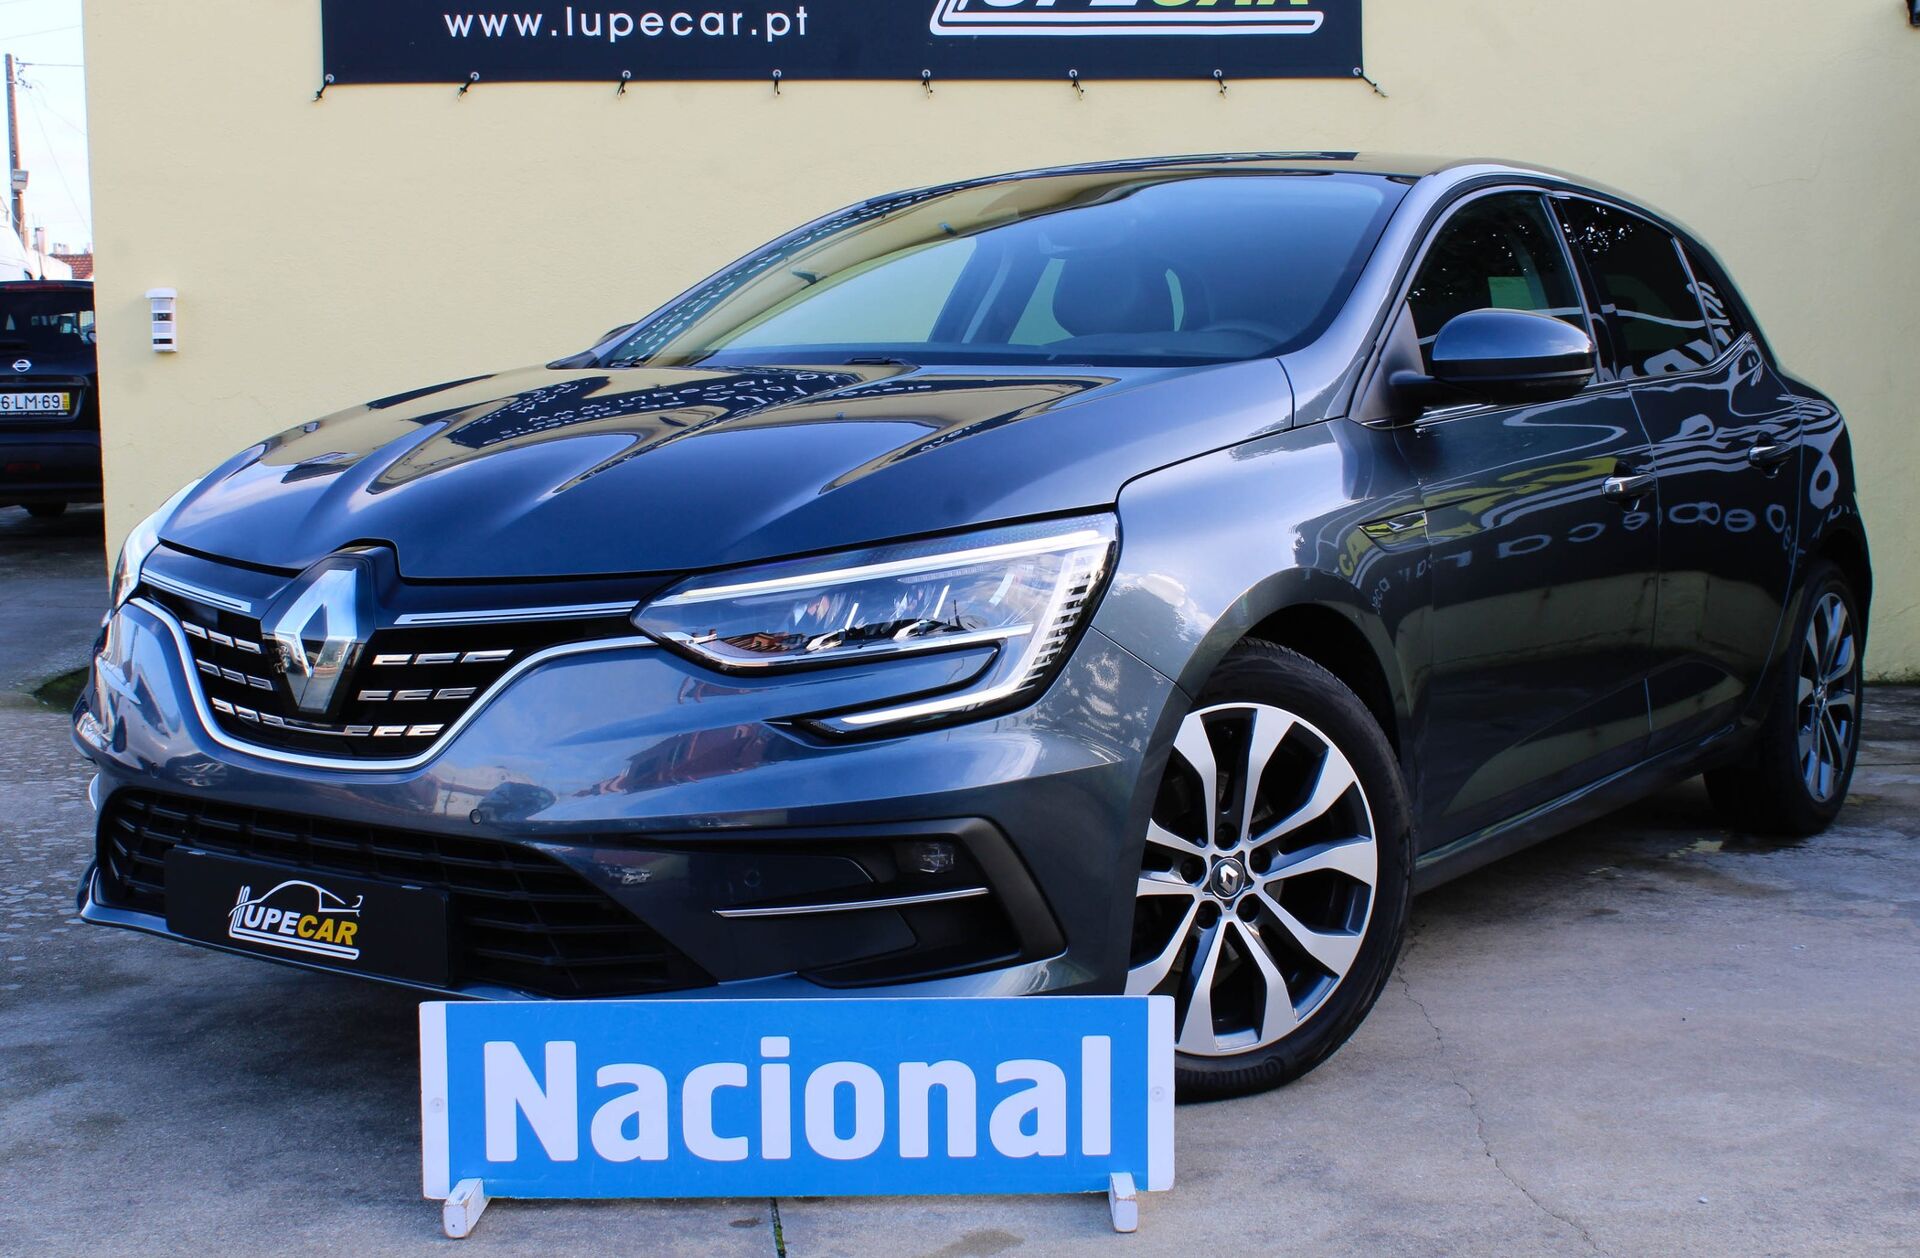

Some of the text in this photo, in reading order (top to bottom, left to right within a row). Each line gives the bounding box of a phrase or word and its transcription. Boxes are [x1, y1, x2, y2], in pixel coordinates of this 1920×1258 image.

[444, 6, 808, 42] www.lupecar.pt
[1, 395, 60, 409] 6-LM-69
[484, 1035, 1112, 1162] Nacional
